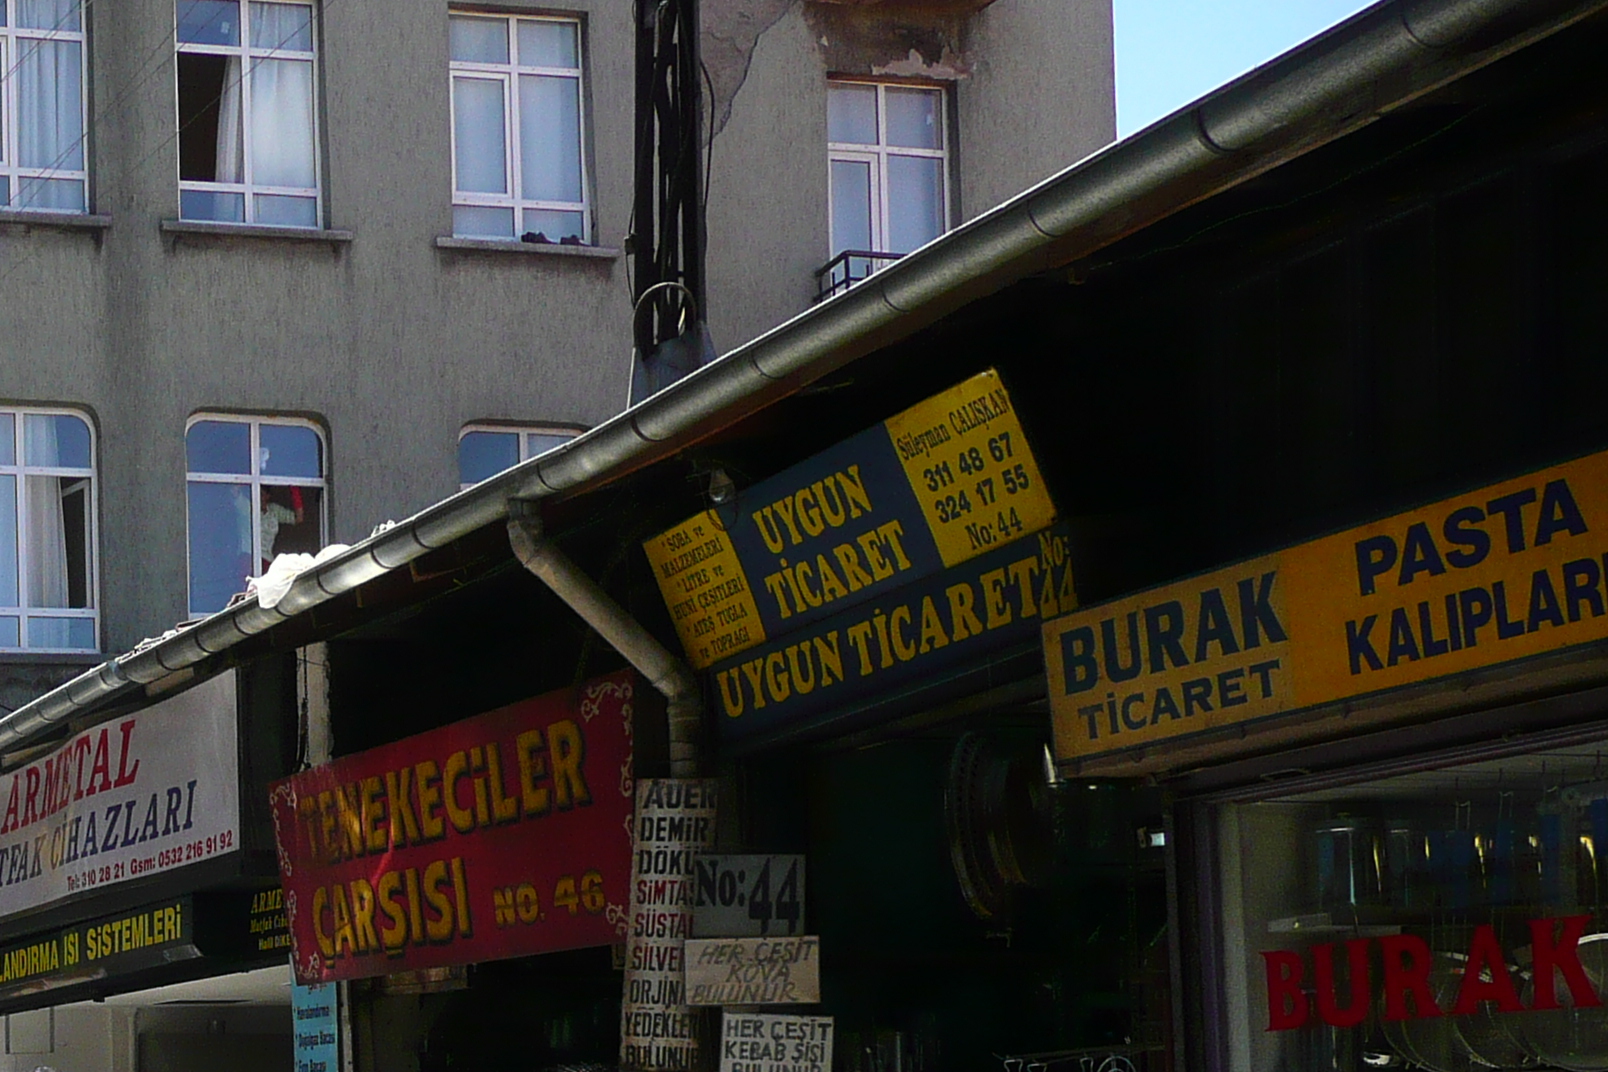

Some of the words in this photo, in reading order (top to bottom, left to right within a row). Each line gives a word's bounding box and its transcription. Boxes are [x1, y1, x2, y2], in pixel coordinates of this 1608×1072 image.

[923, 460, 955, 492] 311
[959, 447, 985, 475] 48
[988, 431, 1013, 463] 67
[751, 463, 873, 554] UYGUN
[935, 490, 972, 523] 324
[976, 477, 996, 506] 17
[1002, 463, 1029, 494] 55
[693, 525, 705, 537] ve
[1355, 478, 1590, 597] PASTA
[712, 564, 725, 577] ve
[763, 519, 912, 619] TİCARET
[716, 630, 844, 718] UYGUN
[847, 555, 1045, 677] TİCARET
[1058, 569, 1288, 697] BURAK
[1077, 659, 1281, 740] TİCARET
[0, 719, 140, 835] ARMETAL
[297, 718, 592, 862] TENEKECİLER
[49, 779, 198, 870] CİHAZLARI
[640, 815, 709, 842] DEMİR
[81, 871, 96, 888] 310
[98, 865, 112, 882] 28
[114, 862, 125, 879] 21
[158, 847, 183, 868] 0532
[185, 840, 204, 861] 216
[638, 843, 695, 875] DÖKÜ
[250, 887, 284, 914] ARME
[311, 856, 473, 969] ÇARŞISI
[554, 870, 607, 916] 46
[635, 909, 695, 938] SÜSTA
[63, 932, 79, 966] ISI
[632, 941, 685, 971] SİLVE
[698, 944, 743, 965] HER
[726, 963, 790, 983] KOVA
[1259, 914, 1605, 1032] BURAK
[725, 1041, 787, 1061] KEBAB
[726, 1020, 765, 1039] HER
